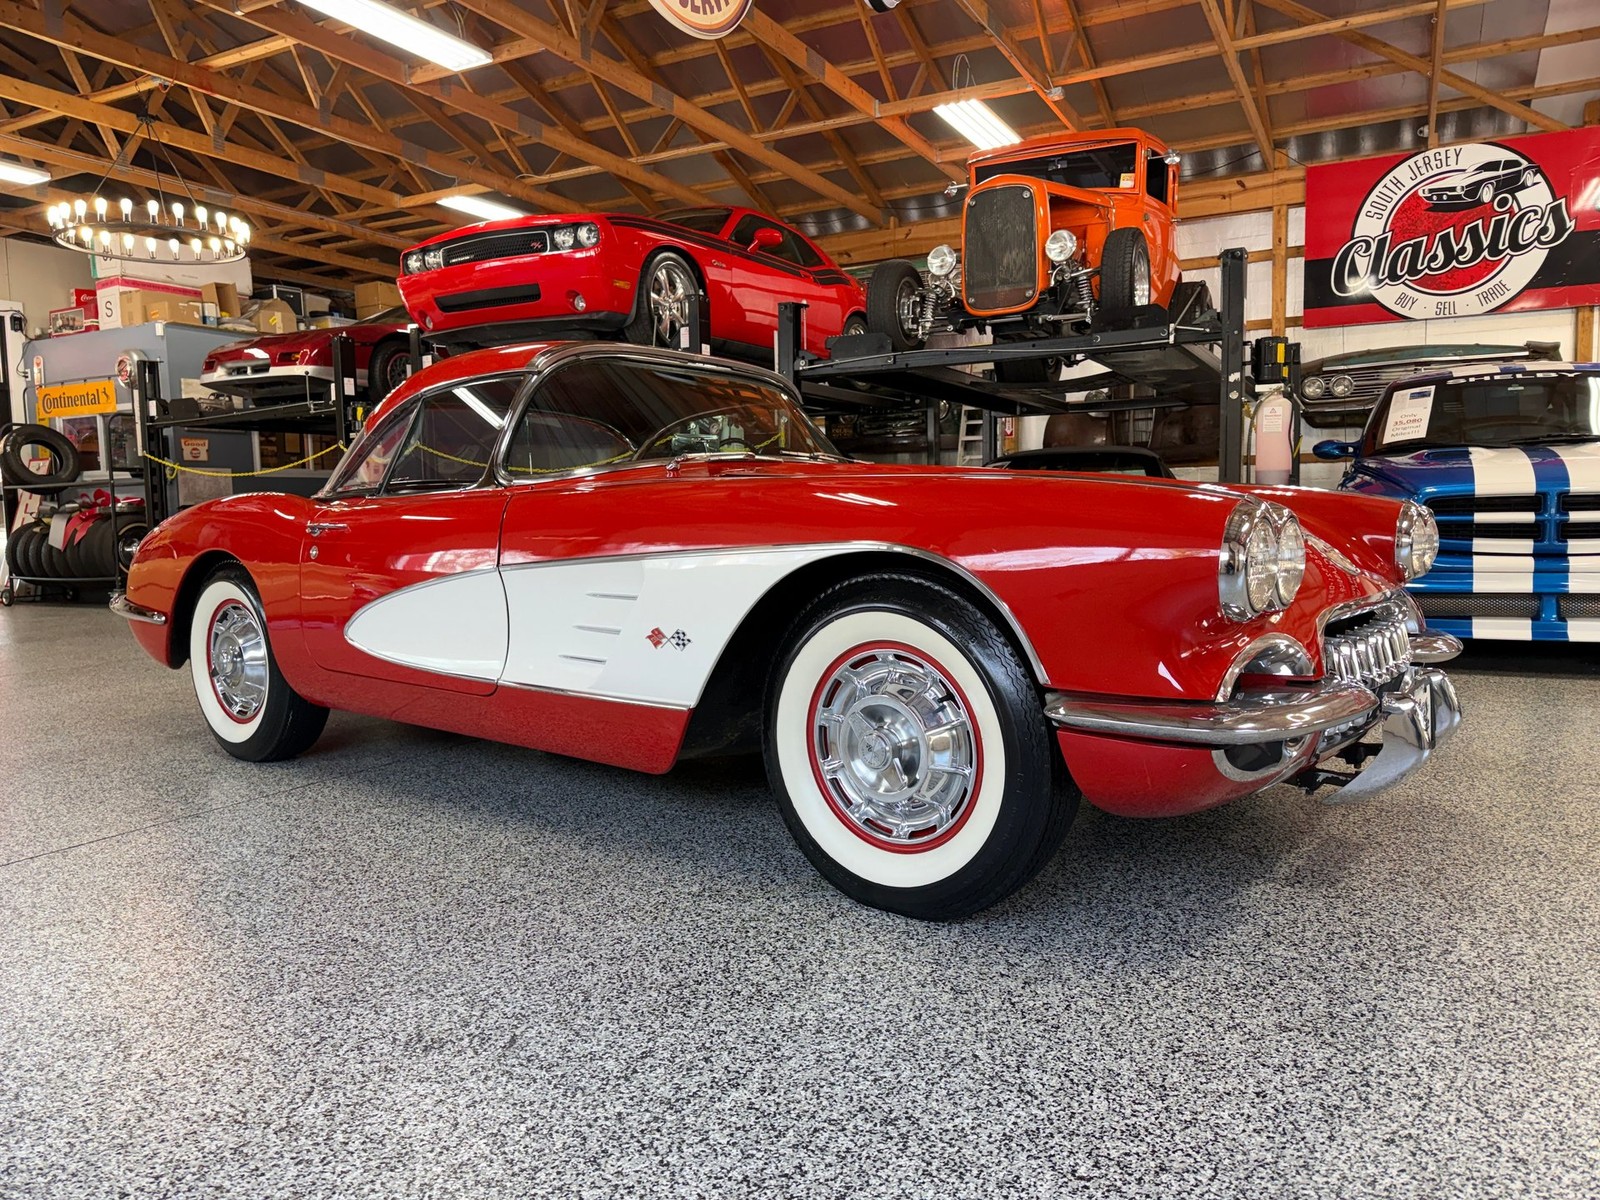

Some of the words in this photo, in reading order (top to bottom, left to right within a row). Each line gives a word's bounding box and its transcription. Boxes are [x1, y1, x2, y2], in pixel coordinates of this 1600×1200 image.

[1365, 175, 1405, 220] SOUTH
[1409, 147, 1463, 181] JERSEY
[1331, 194, 1577, 297] Classics
[1394, 291, 1418, 311] BUY
[1434, 301, 1458, 316] SELL
[1474, 278, 1512, 307] TRADE
[42, 388, 101, 414] Continental
[183, 439, 207, 447] Good
